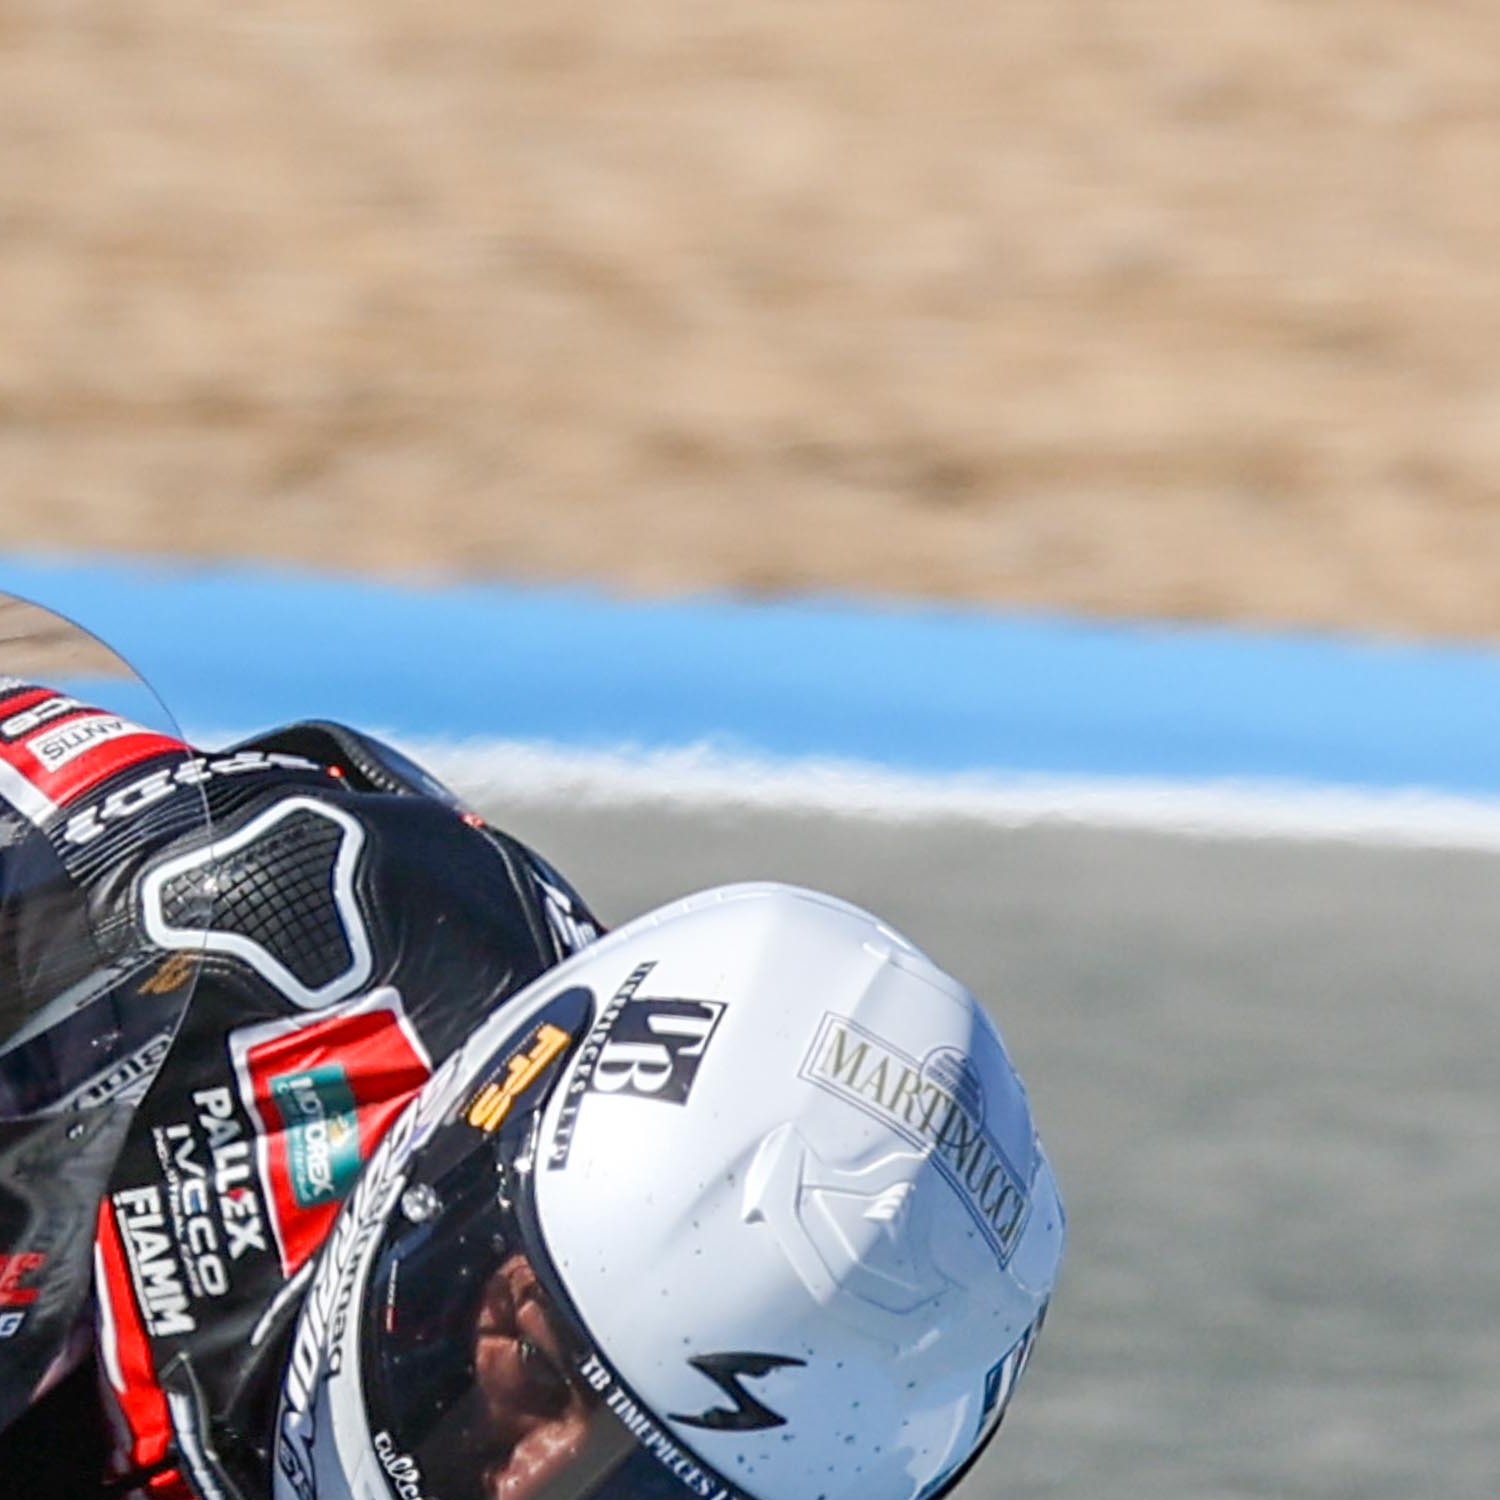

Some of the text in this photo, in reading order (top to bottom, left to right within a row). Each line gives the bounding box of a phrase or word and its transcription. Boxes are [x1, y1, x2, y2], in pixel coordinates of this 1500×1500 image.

[165, 1122, 229, 1297] IVECO
[818, 1026, 1027, 1246] MARTINUCCI
[114, 1185, 196, 1337] FIAMM
[580, 1352, 612, 1391] TB
